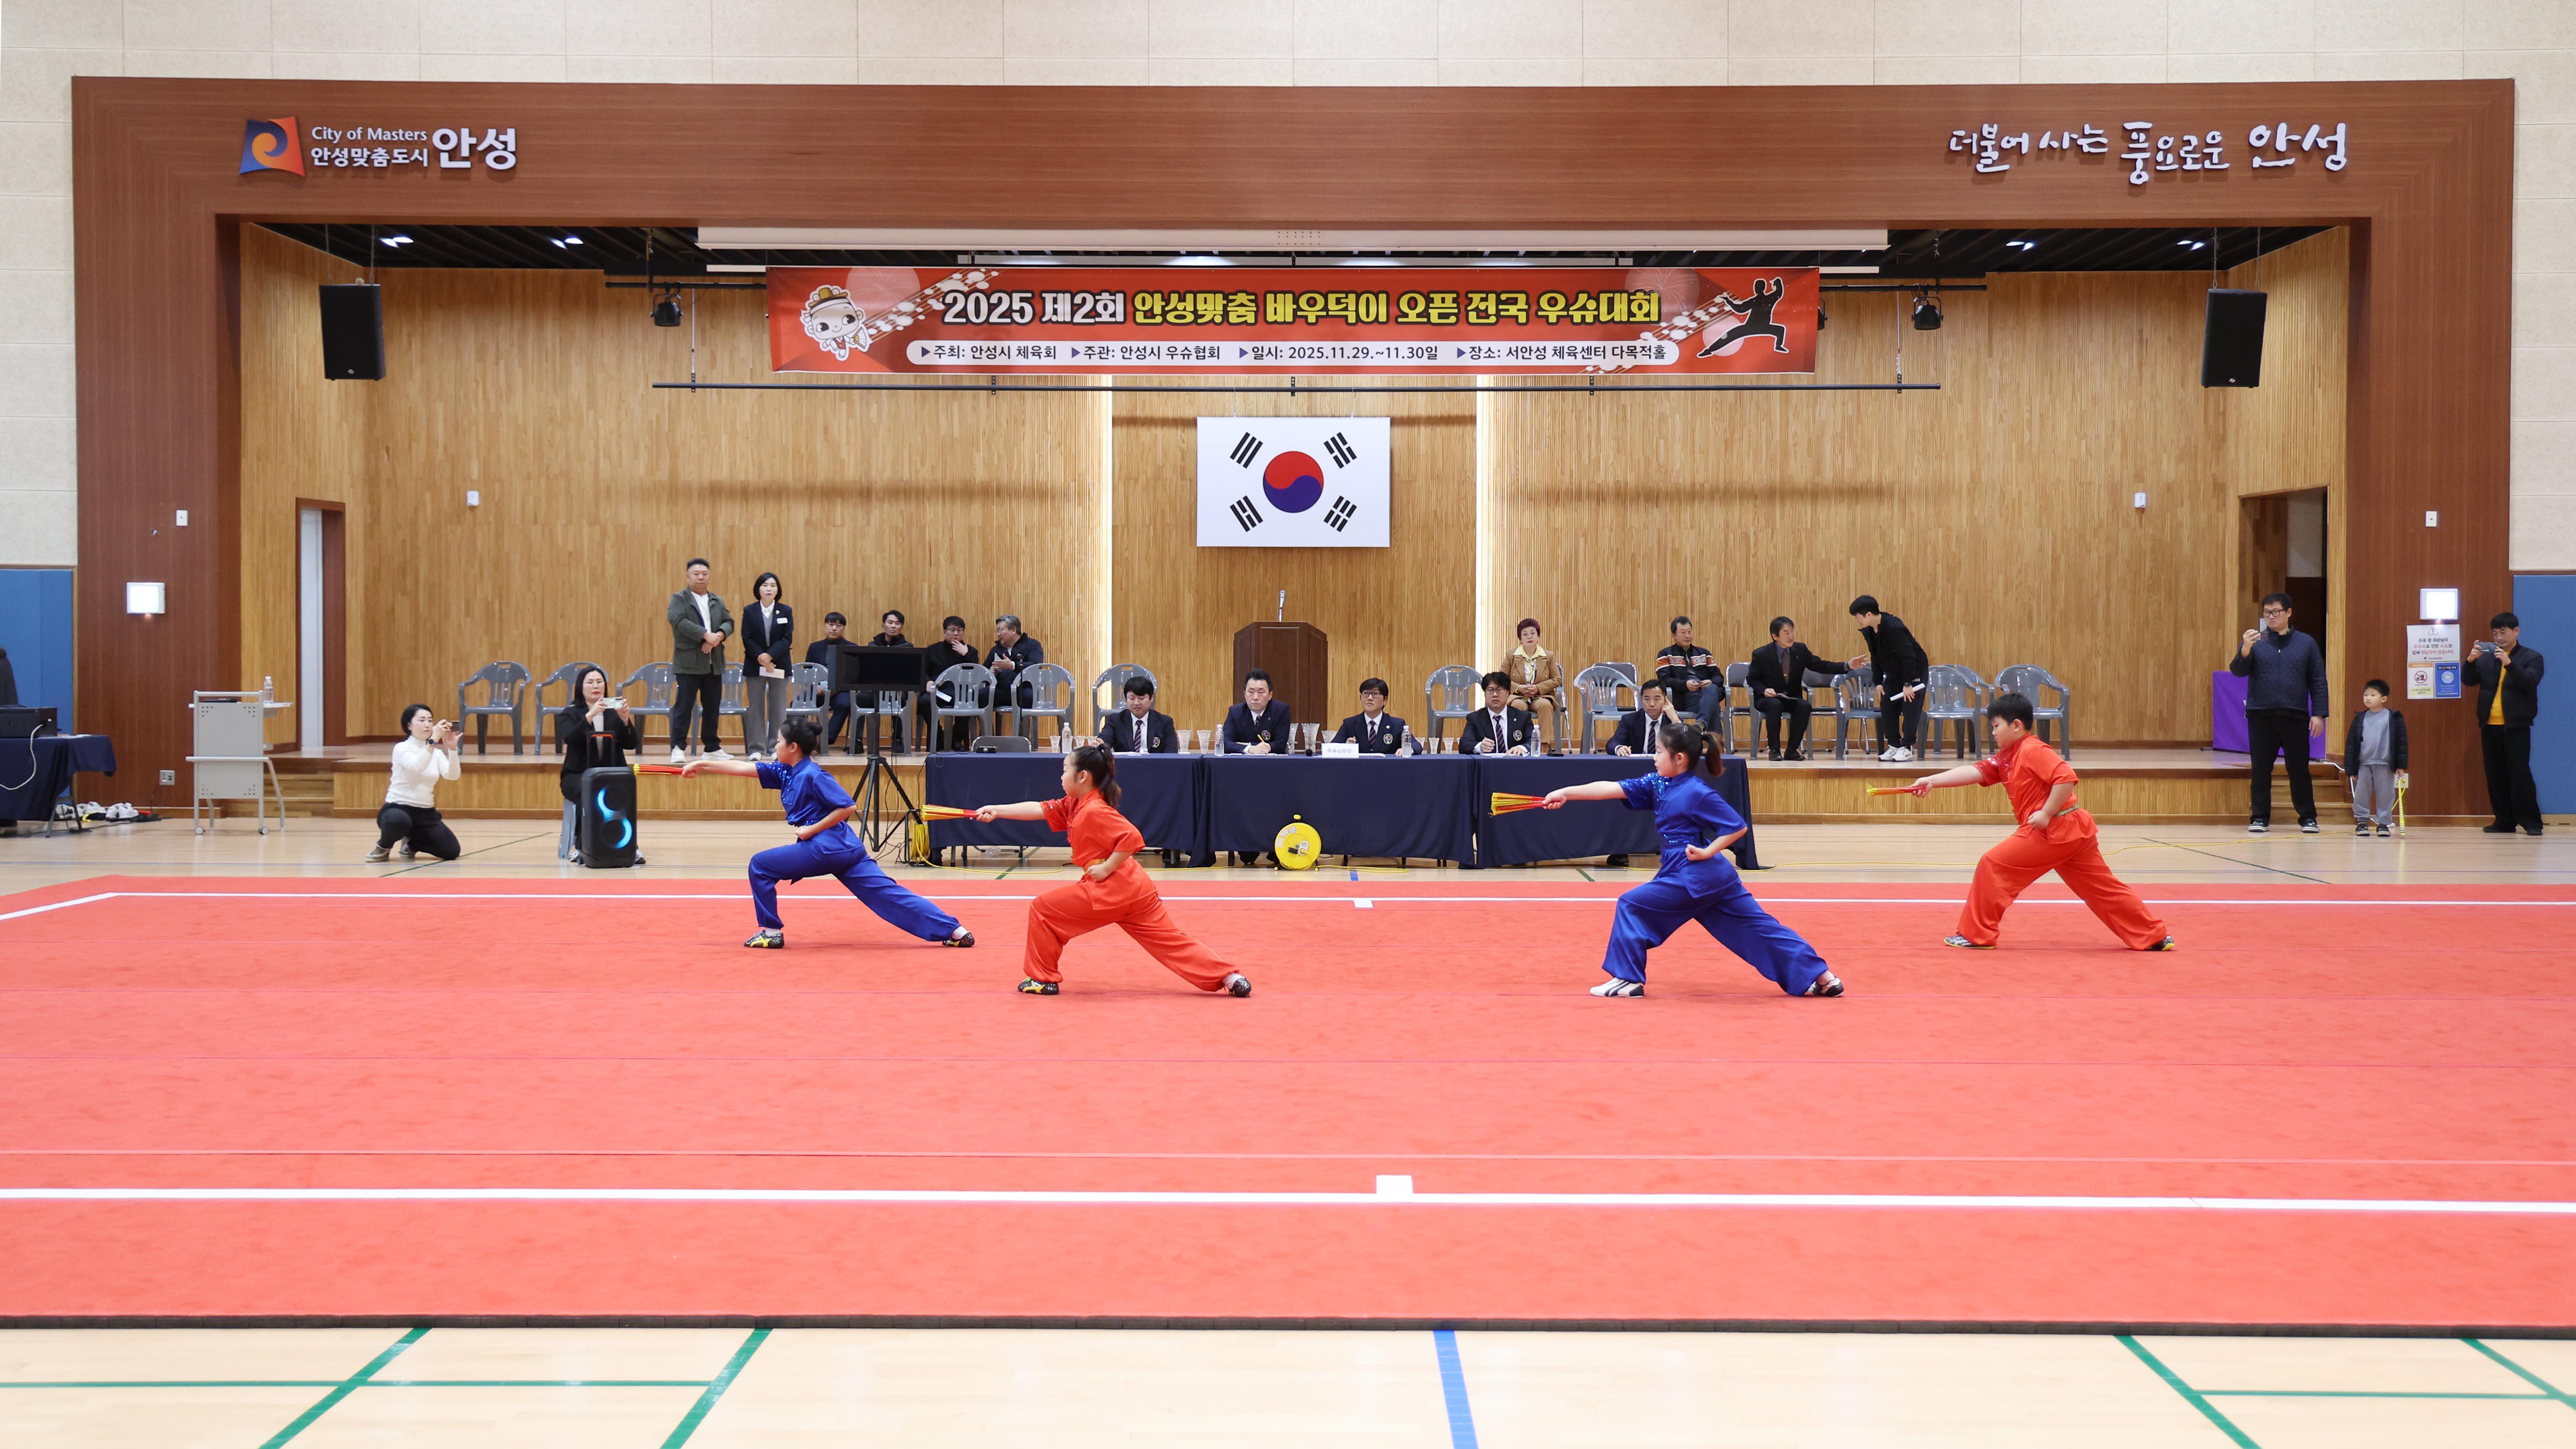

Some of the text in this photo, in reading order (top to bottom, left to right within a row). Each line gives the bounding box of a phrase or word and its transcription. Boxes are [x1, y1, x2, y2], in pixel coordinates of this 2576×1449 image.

[312, 126, 427, 144] City of Masters
[311, 147, 428, 167] 안성맞춤도시
[432, 128, 516, 170] 안성
[1950, 121, 2348, 185] 더불어 사는 풍요로운 안성
[943, 291, 1660, 324] 2025 제2회 안성맞춤 바우덕이 오픈 전국 우슈대회
[934, 345, 1666, 360] 주최: 안성시 체육회 주관: 안성시 우슈협회 일시: 2025.11.29.~11.30일 장소: 서안성 체육센터 다목적홀
